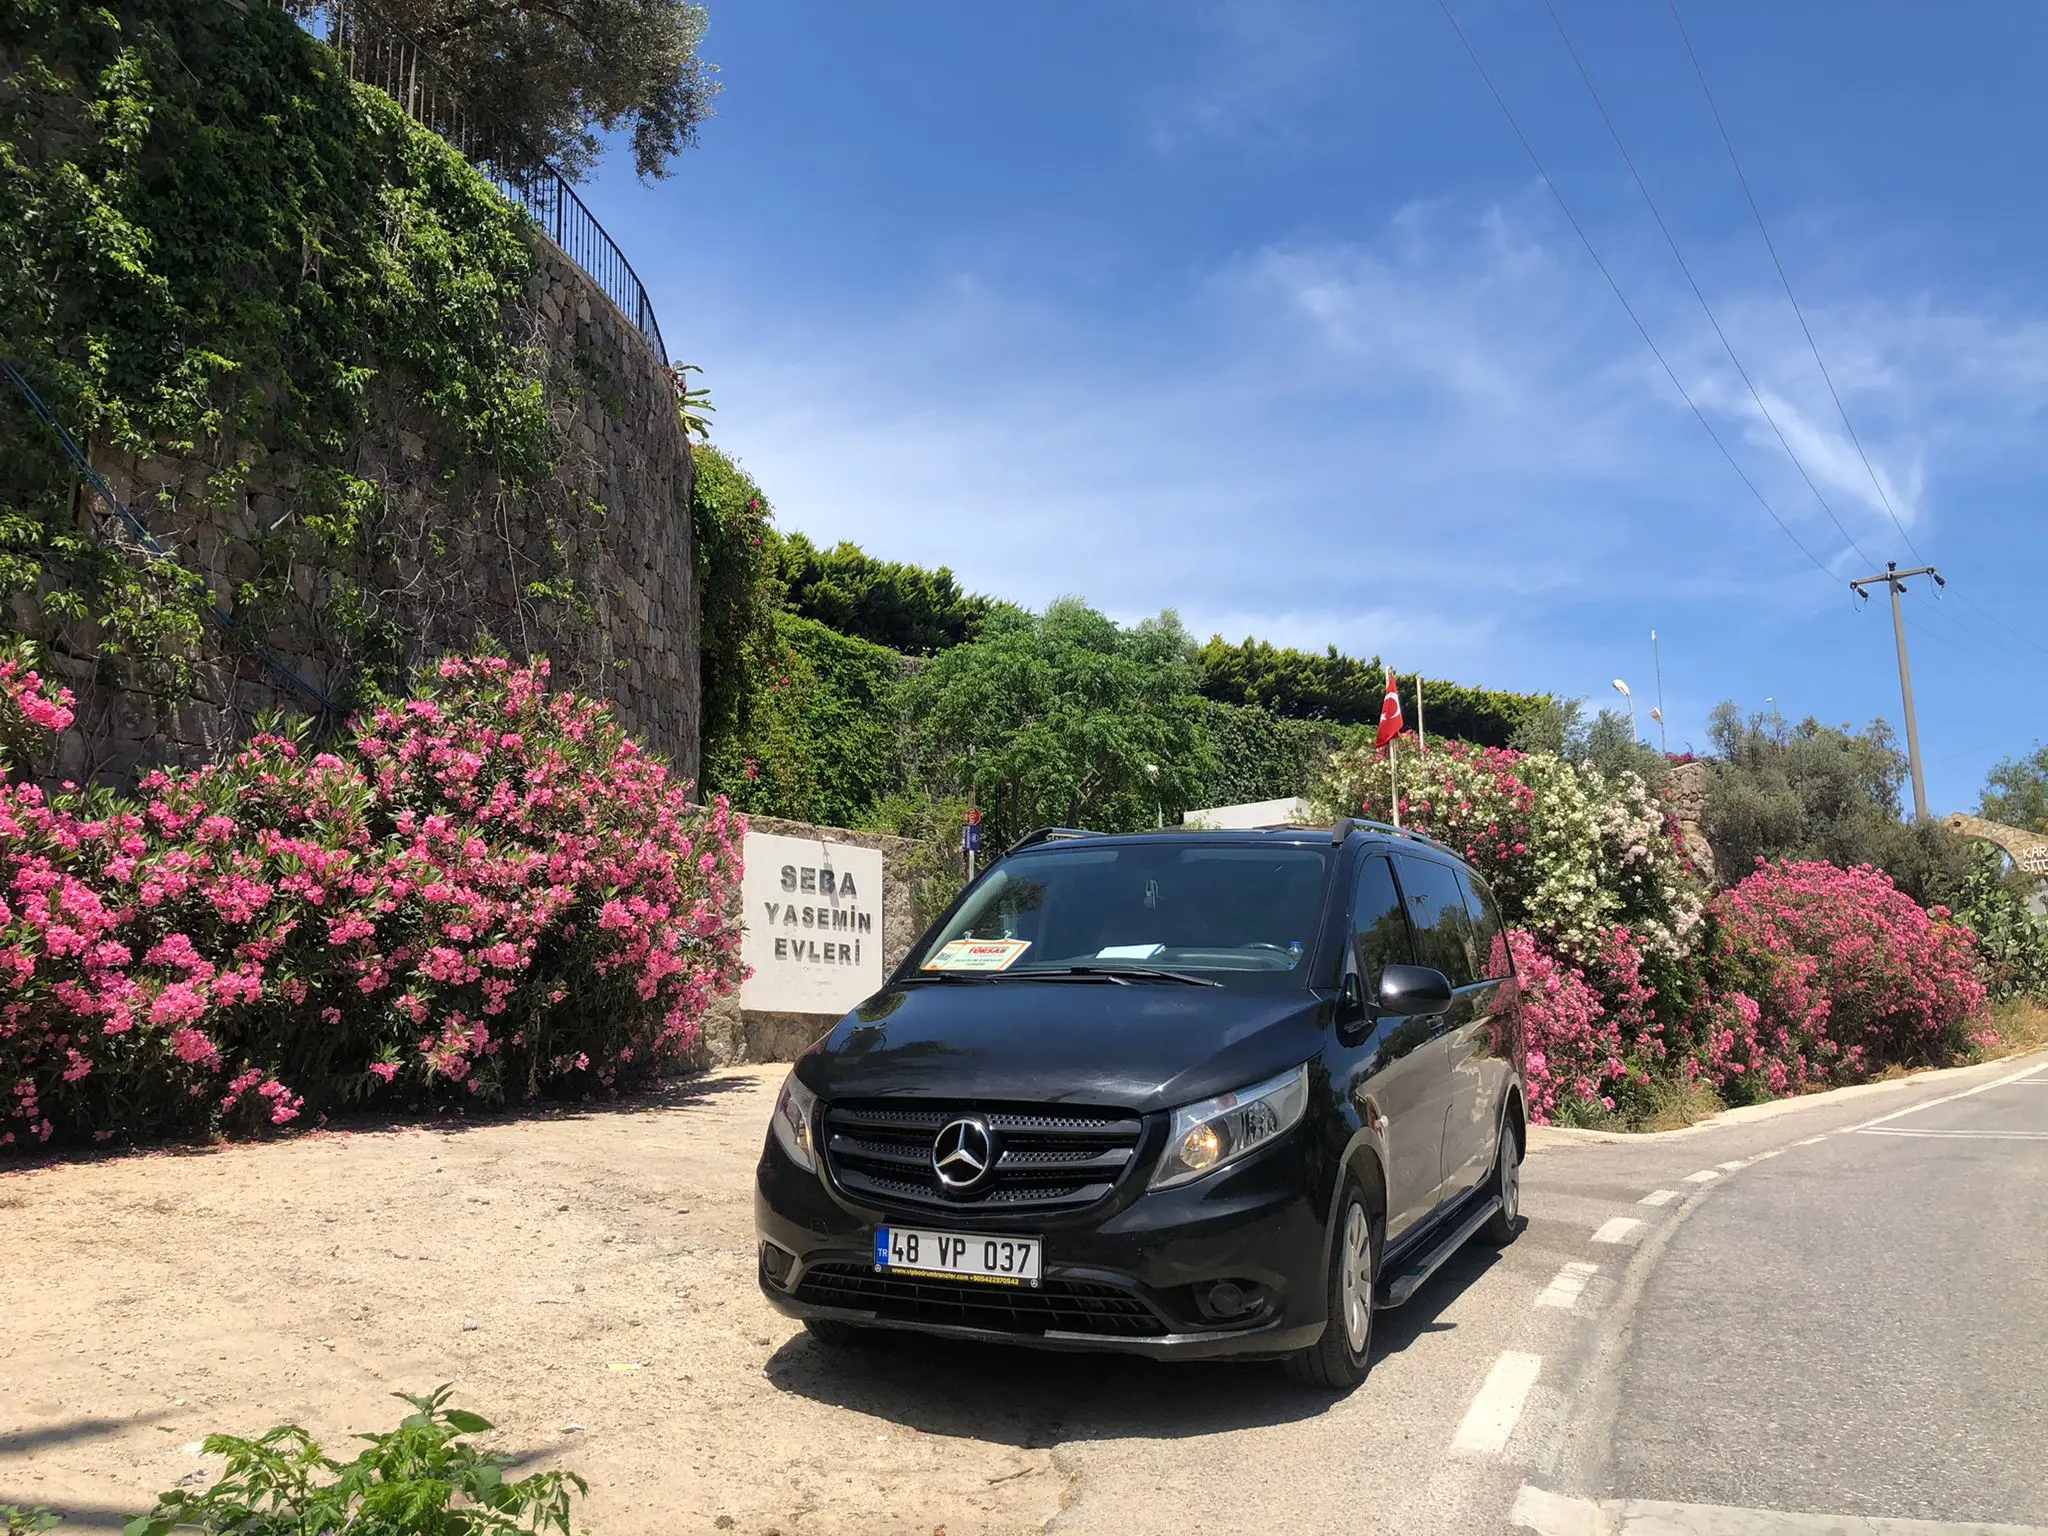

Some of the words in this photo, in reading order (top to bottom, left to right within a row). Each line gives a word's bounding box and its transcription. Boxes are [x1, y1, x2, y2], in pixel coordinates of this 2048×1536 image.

[780, 865, 857, 898] SEBA
[764, 902, 871, 934] YASEMİN
[774, 937, 860, 966] EVLERİ
[878, 1247, 888, 1257] TR
[891, 1232, 919, 1263] 48
[938, 1236, 966, 1268] VP
[984, 1241, 1031, 1273] 037
